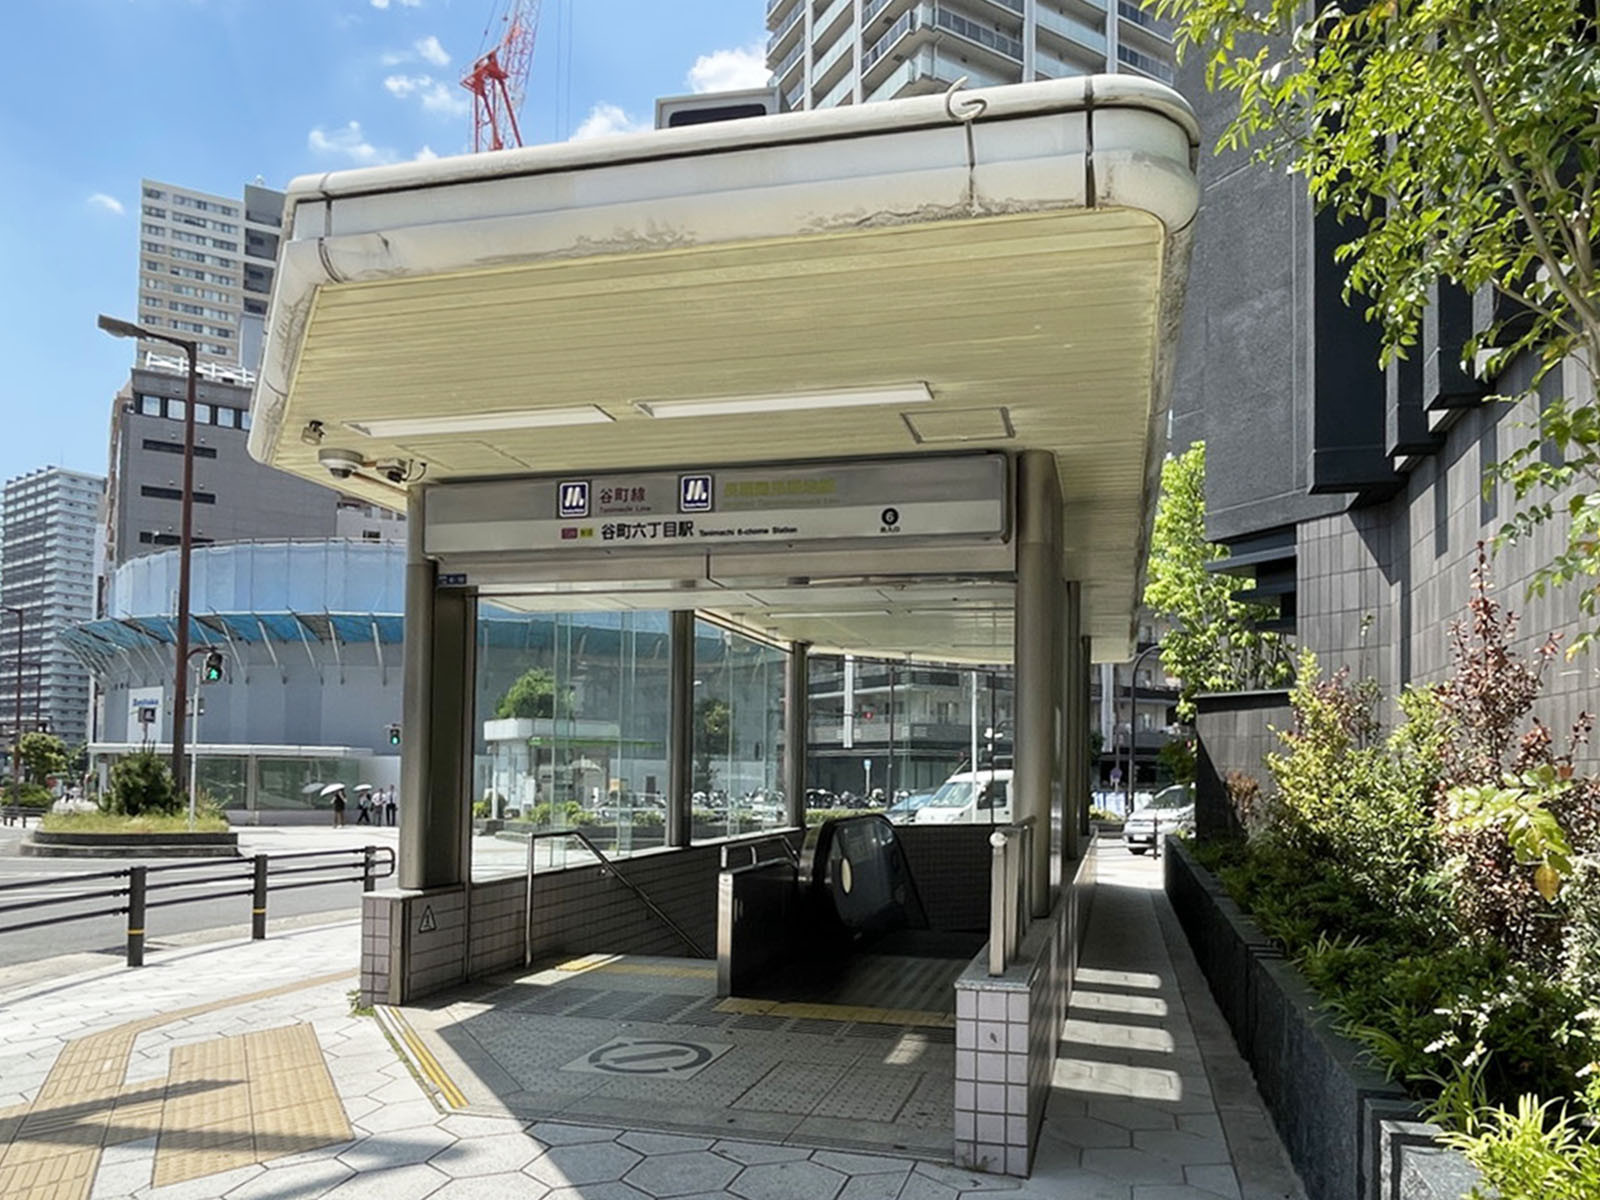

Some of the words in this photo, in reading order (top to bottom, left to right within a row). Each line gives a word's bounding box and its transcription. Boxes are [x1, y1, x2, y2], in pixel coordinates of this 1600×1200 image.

[600, 487, 646, 504] 谷町線
[601, 521, 694, 540] 谷町六丁目駅
